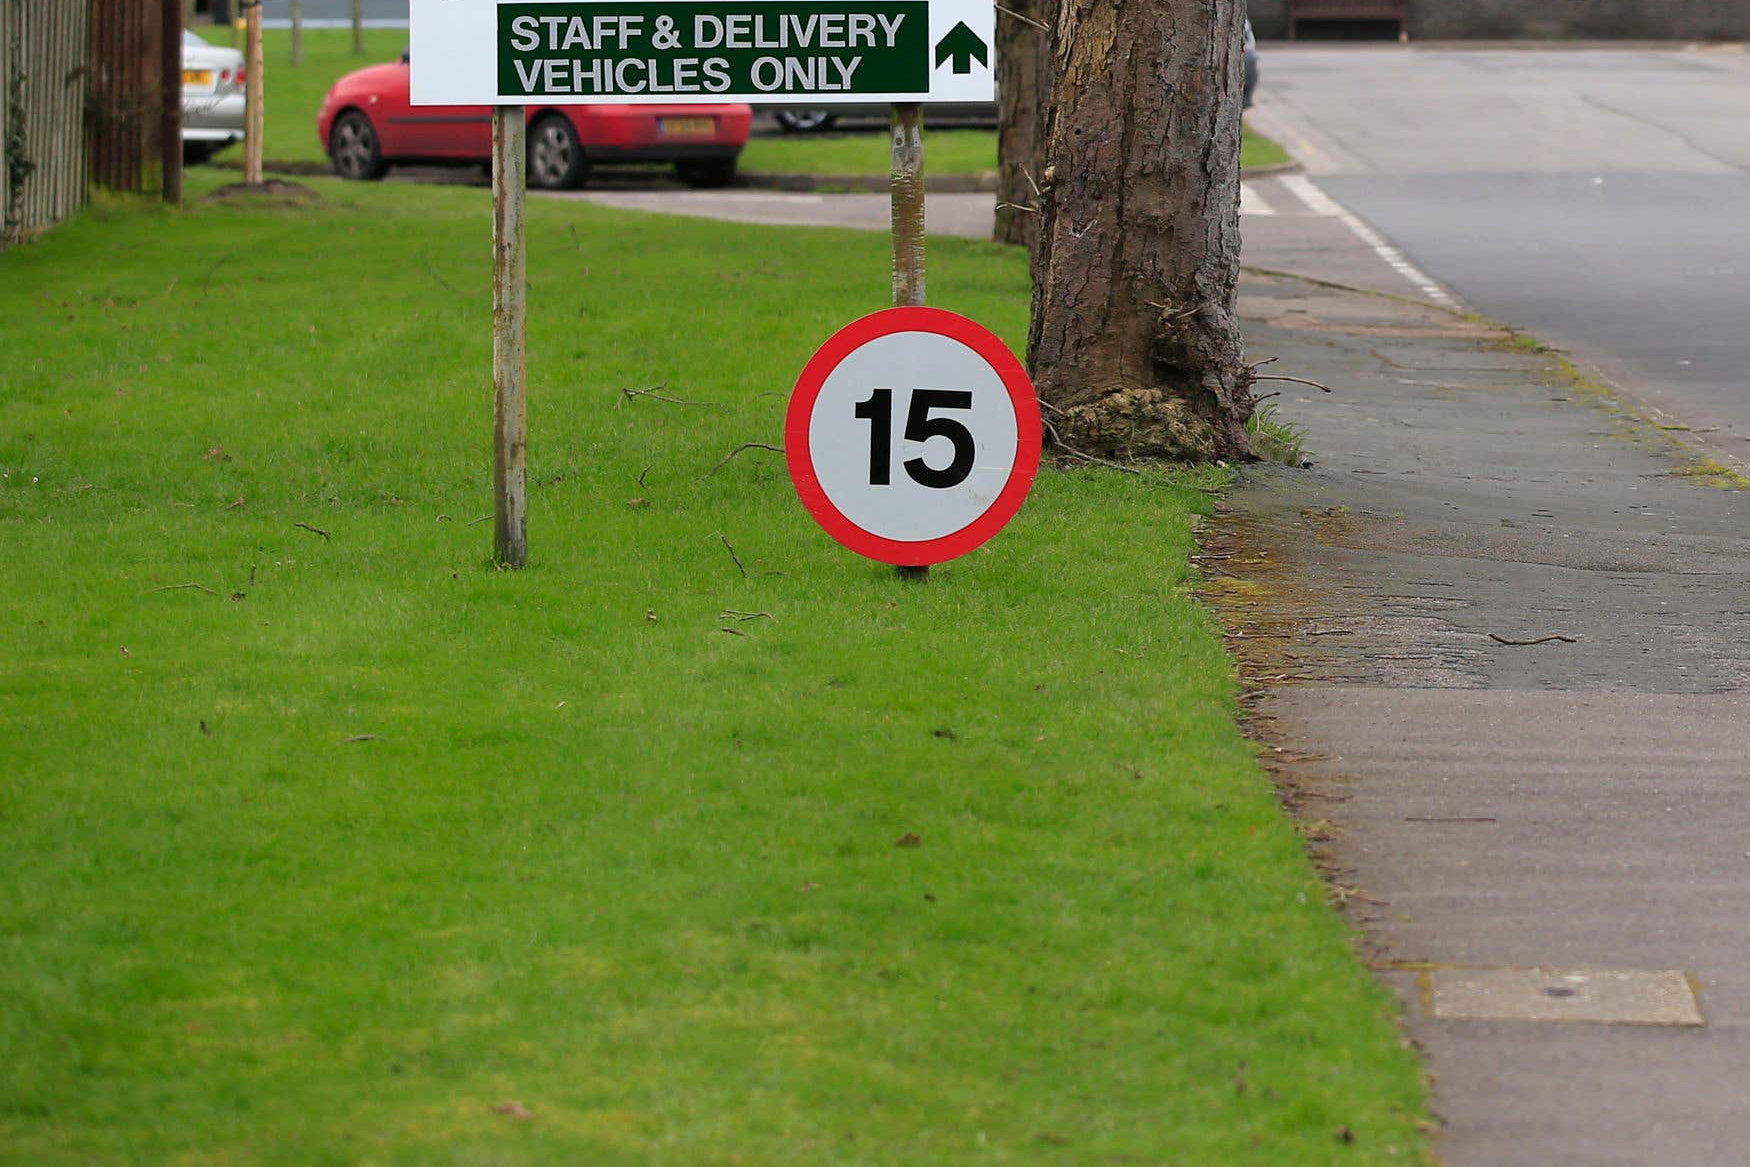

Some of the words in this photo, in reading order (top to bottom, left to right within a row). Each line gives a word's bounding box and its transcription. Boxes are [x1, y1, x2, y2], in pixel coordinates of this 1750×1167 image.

[510, 16, 644, 51] STAFF
[651, 15, 682, 49] &
[694, 14, 905, 49] DELIVERY
[514, 57, 731, 93] VEHICLES
[751, 56, 862, 91] ONLY
[855, 389, 975, 489] 15
